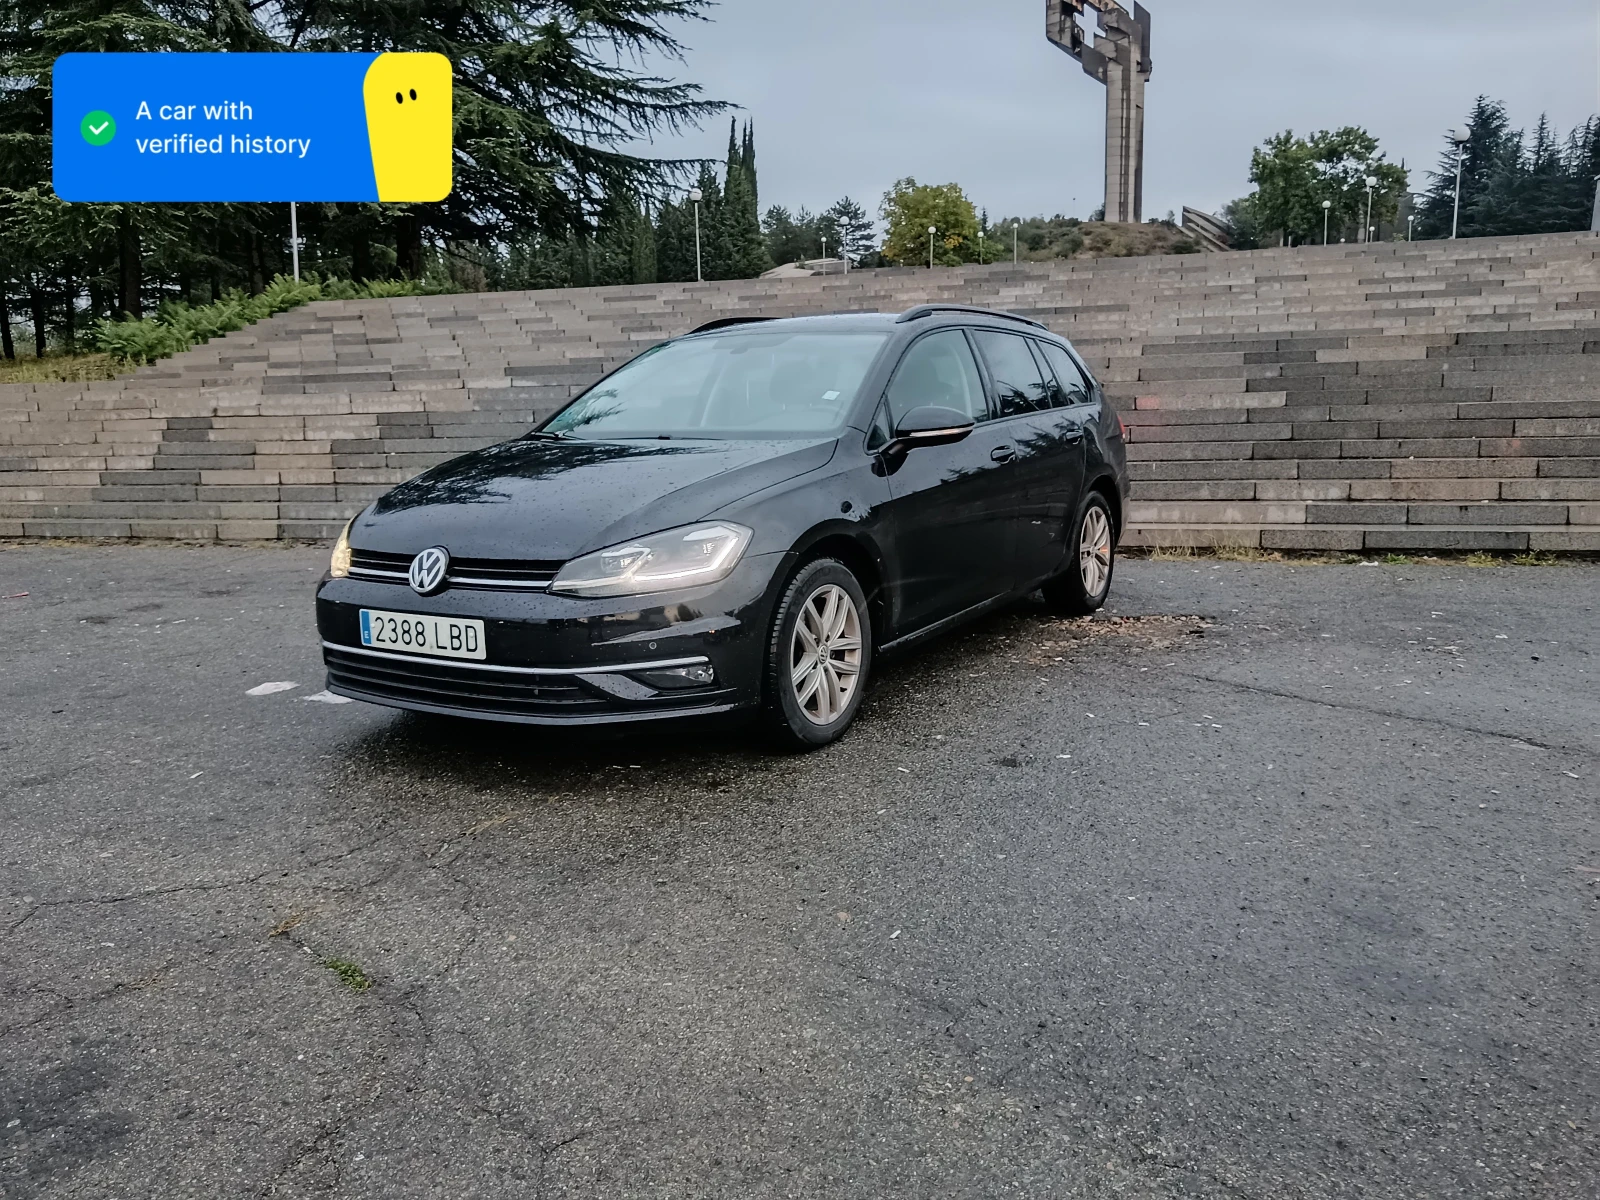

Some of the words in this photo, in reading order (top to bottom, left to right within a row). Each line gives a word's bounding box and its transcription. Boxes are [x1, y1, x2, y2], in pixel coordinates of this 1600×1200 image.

[409, 549, 446, 593] VW
[364, 630, 370, 639] E
[374, 616, 426, 647] 2388
[434, 621, 478, 653] LBD
